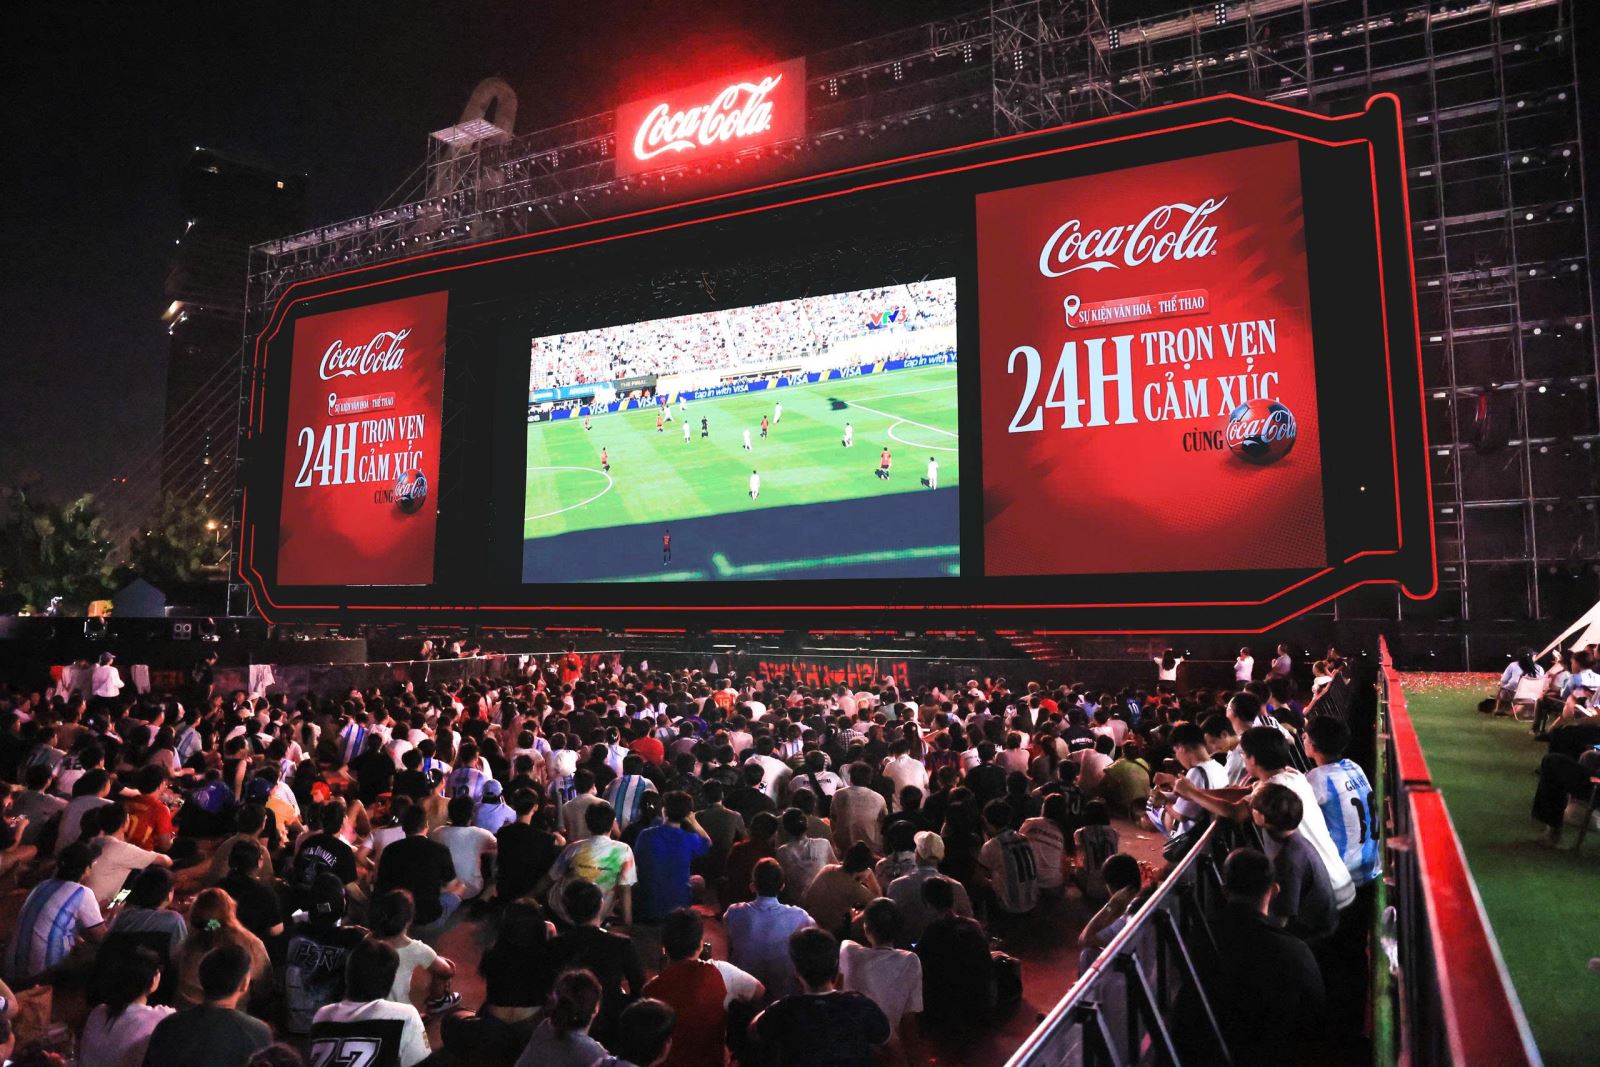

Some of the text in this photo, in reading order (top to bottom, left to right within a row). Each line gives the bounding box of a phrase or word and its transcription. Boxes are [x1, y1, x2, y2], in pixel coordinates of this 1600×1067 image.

[634, 73, 783, 160] Coca-Cola
[1039, 196, 1228, 278] Coca-Cola
[1179, 296, 1205, 310] THAO
[319, 328, 412, 381] Coca-Cola
[1141, 319, 1277, 370] TRỌN VẸN
[733, 384, 749, 393] VISA
[788, 372, 809, 387] VISA
[840, 366, 862, 380] VISA
[1007, 335, 1138, 434] 24H
[590, 403, 609, 416] VISA
[638, 397, 657, 409] VISA
[1144, 372, 1209, 422] CẢM
[362, 414, 425, 448] TRỌN VẸN
[1183, 428, 1224, 453] CÙNG
[294, 422, 359, 488] 24H
[359, 448, 391, 483] CẢM
